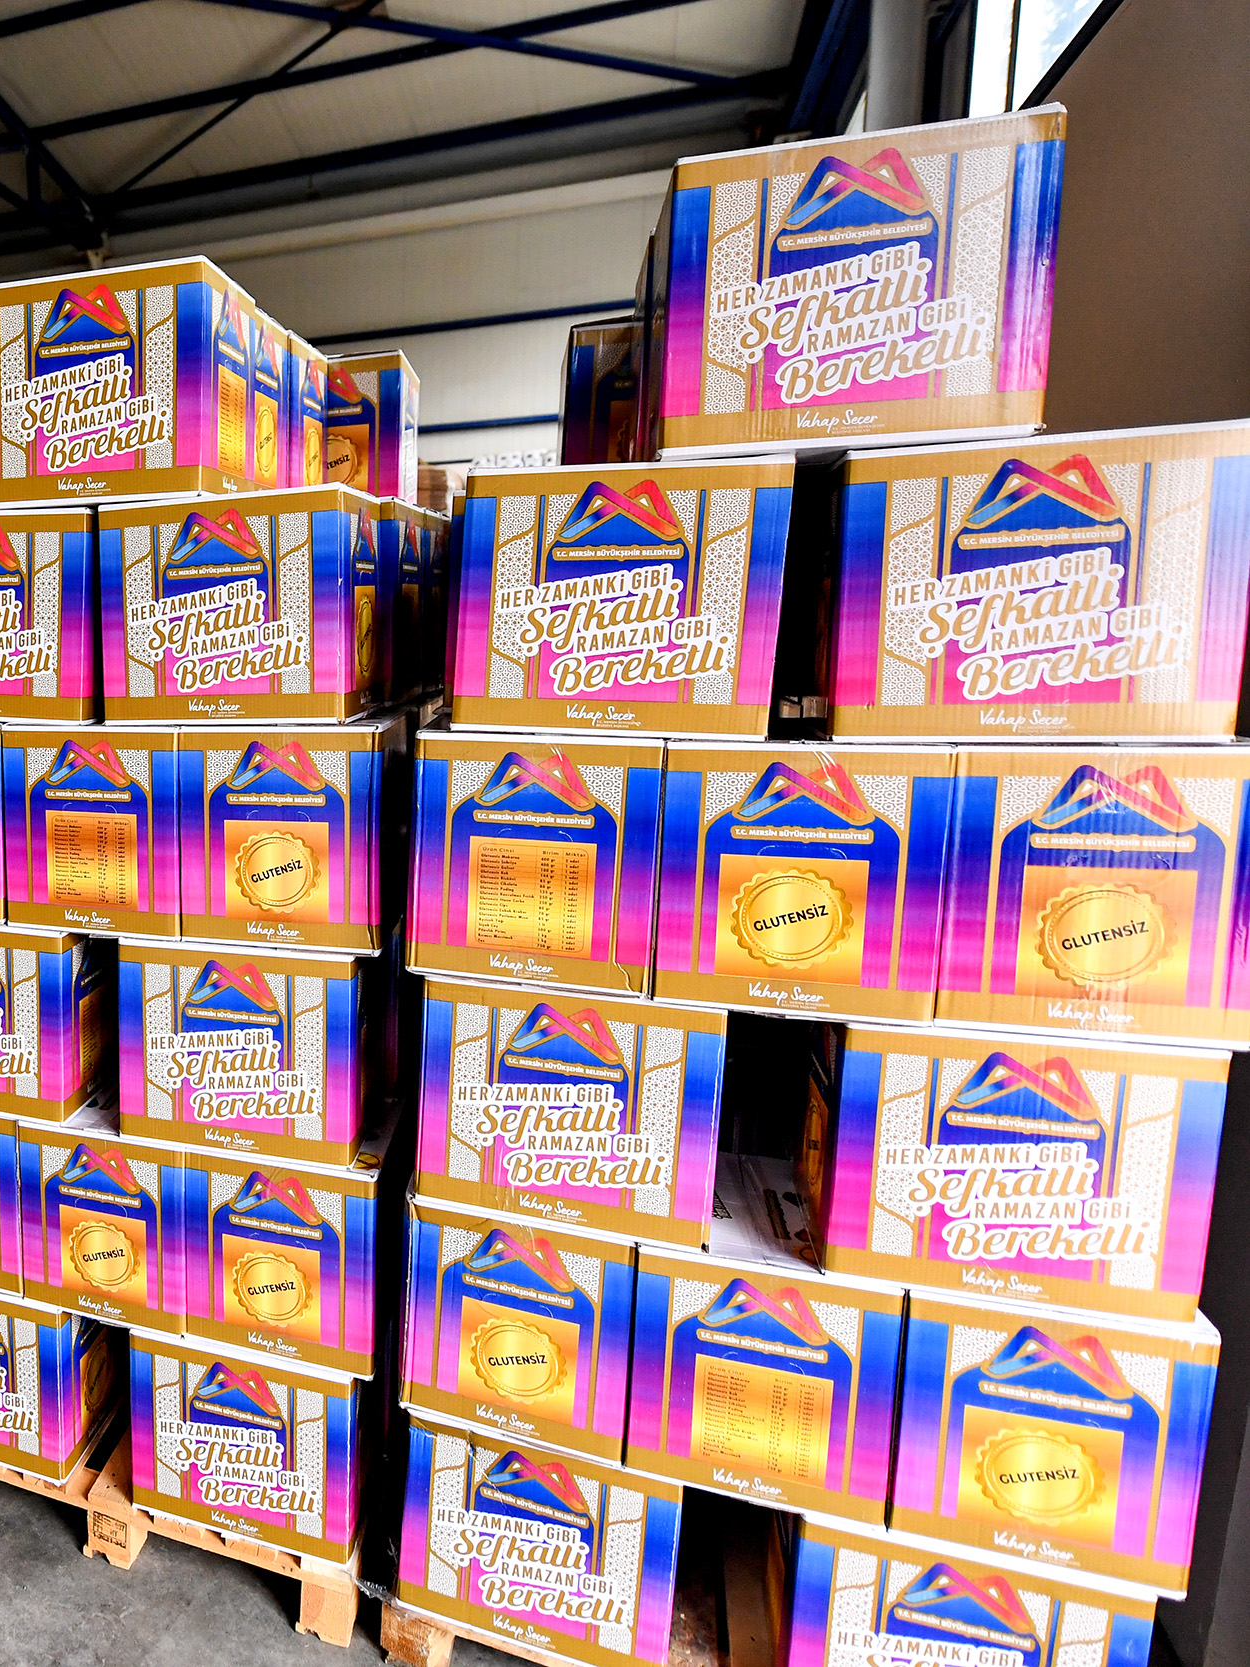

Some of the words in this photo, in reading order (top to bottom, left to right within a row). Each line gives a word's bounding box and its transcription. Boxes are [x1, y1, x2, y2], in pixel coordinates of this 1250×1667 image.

[718, 286, 757, 313] HER
[741, 262, 928, 359] Şefkatli
[808, 312, 911, 353] RAMAZAN
[780, 317, 986, 400] Bereketli
[5, 383, 29, 403] HER
[21, 368, 130, 438] Şefkatli
[62, 405, 122, 434] RAMAZAN
[797, 411, 841, 435] Vahap
[46, 410, 167, 469] Bereketli
[327, 454, 351, 470] TENSİZ
[501, 589, 535, 609] HER
[895, 582, 937, 606] HER
[132, 604, 156, 622] HER
[520, 581, 680, 653] Şefkatli
[192, 629, 256, 656] RAMAZAN
[577, 625, 665, 653] RAMAZAN
[992, 616, 1102, 651] RAMAZAN
[176, 636, 304, 690] Bereketli
[553, 636, 729, 693] Bereketli
[962, 626, 1183, 696] Bereketli
[566, 704, 604, 727] Vahap
[251, 859, 303, 884] GLUTENSİZ
[754, 904, 829, 932] GLUTENSİZ
[1061, 919, 1148, 950] GLUTENSİZ
[490, 953, 523, 975] Vahap
[749, 982, 789, 1006] Vahap
[151, 1036, 175, 1050] HER
[209, 1075, 271, 1090] RAMAZAN
[459, 1086, 489, 1101] HER
[193, 1088, 317, 1120] Bereketli
[528, 1135, 608, 1153] RAMAZAN
[887, 1148, 925, 1165] HER
[507, 1153, 666, 1186] Bereketli
[519, 1194, 554, 1217] Vahap
[975, 1202, 1077, 1220] RAMAZAN
[947, 1221, 1151, 1257] Bereketli
[83, 1247, 125, 1263] GLUTENSİZ
[248, 1280, 297, 1296] GLUTENSİZ
[488, 1351, 547, 1367] GLUTENSİZ
[999, 1466, 1081, 1484] GLUTENSİZ
[437, 1508, 466, 1526] HER
[502, 1562, 575, 1589] RAMAZAN
[482, 1577, 628, 1626] Bereketli
